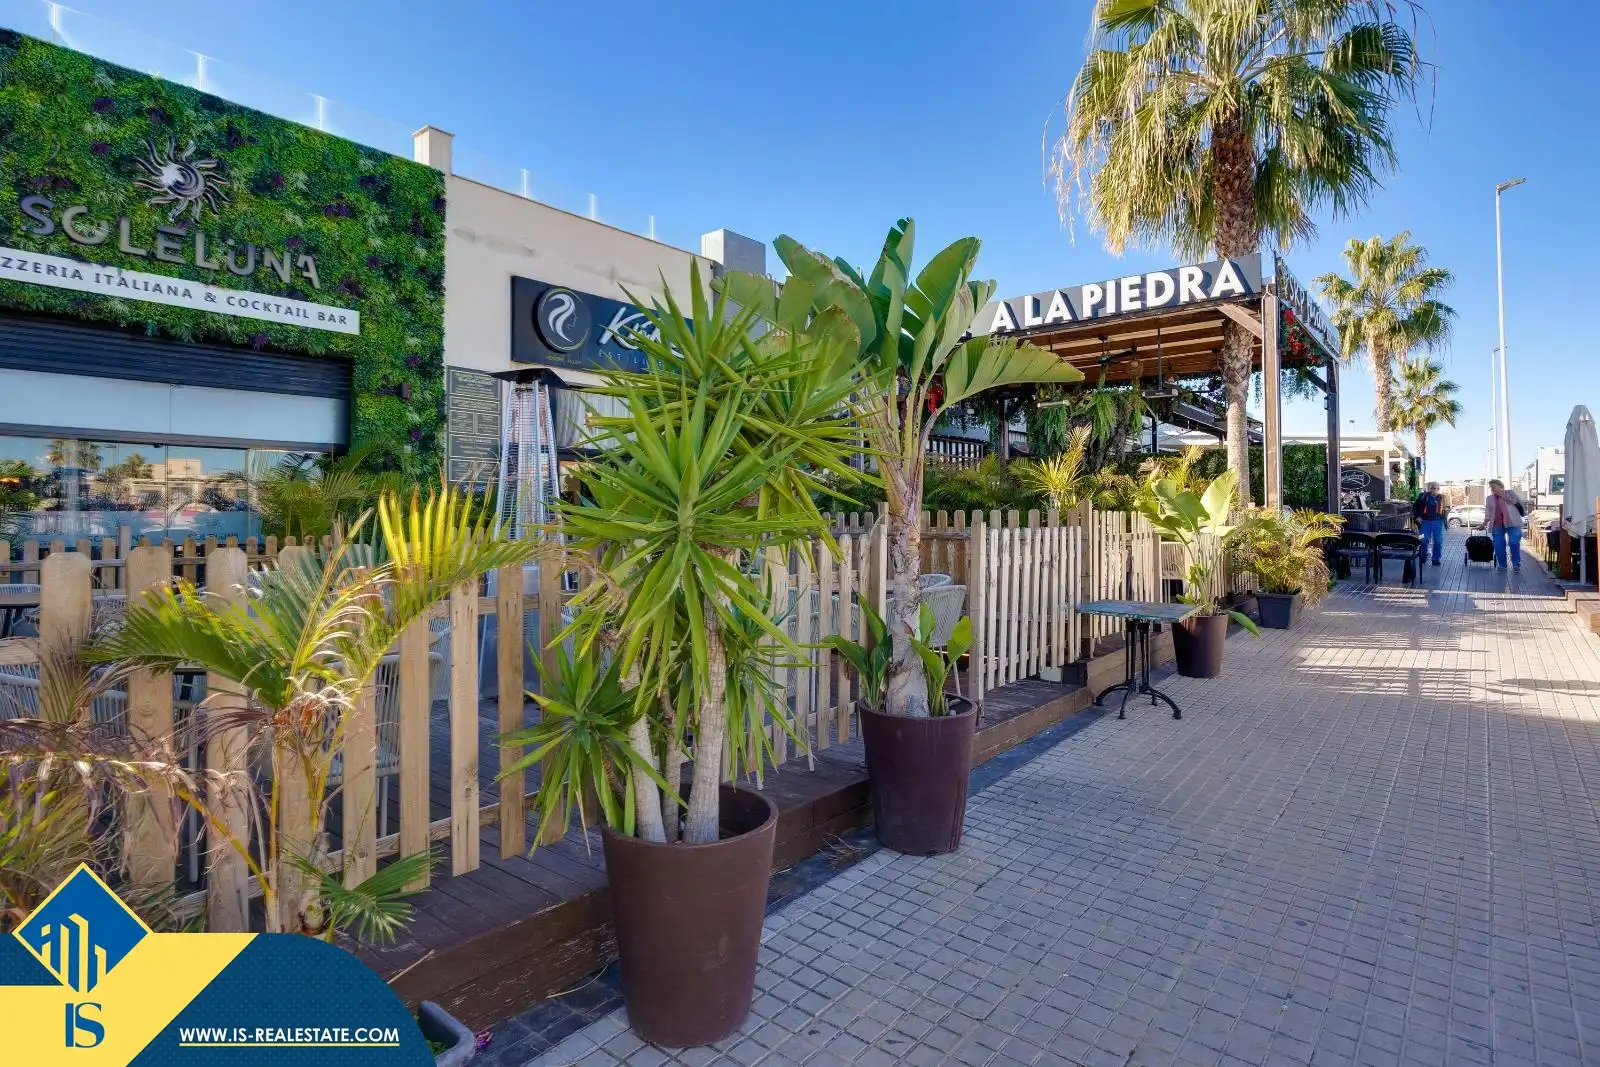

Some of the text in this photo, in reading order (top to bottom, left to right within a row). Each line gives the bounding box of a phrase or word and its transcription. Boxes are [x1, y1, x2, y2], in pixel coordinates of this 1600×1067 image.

[20, 195, 321, 289] SOLELUNA
[94, 273, 193, 299] ITALIANA
[204, 292, 217, 303] &
[227, 296, 310, 319] COCKTAIL
[318, 311, 347, 325] BAR
[988, 258, 1246, 333] A LA PIEDRA
